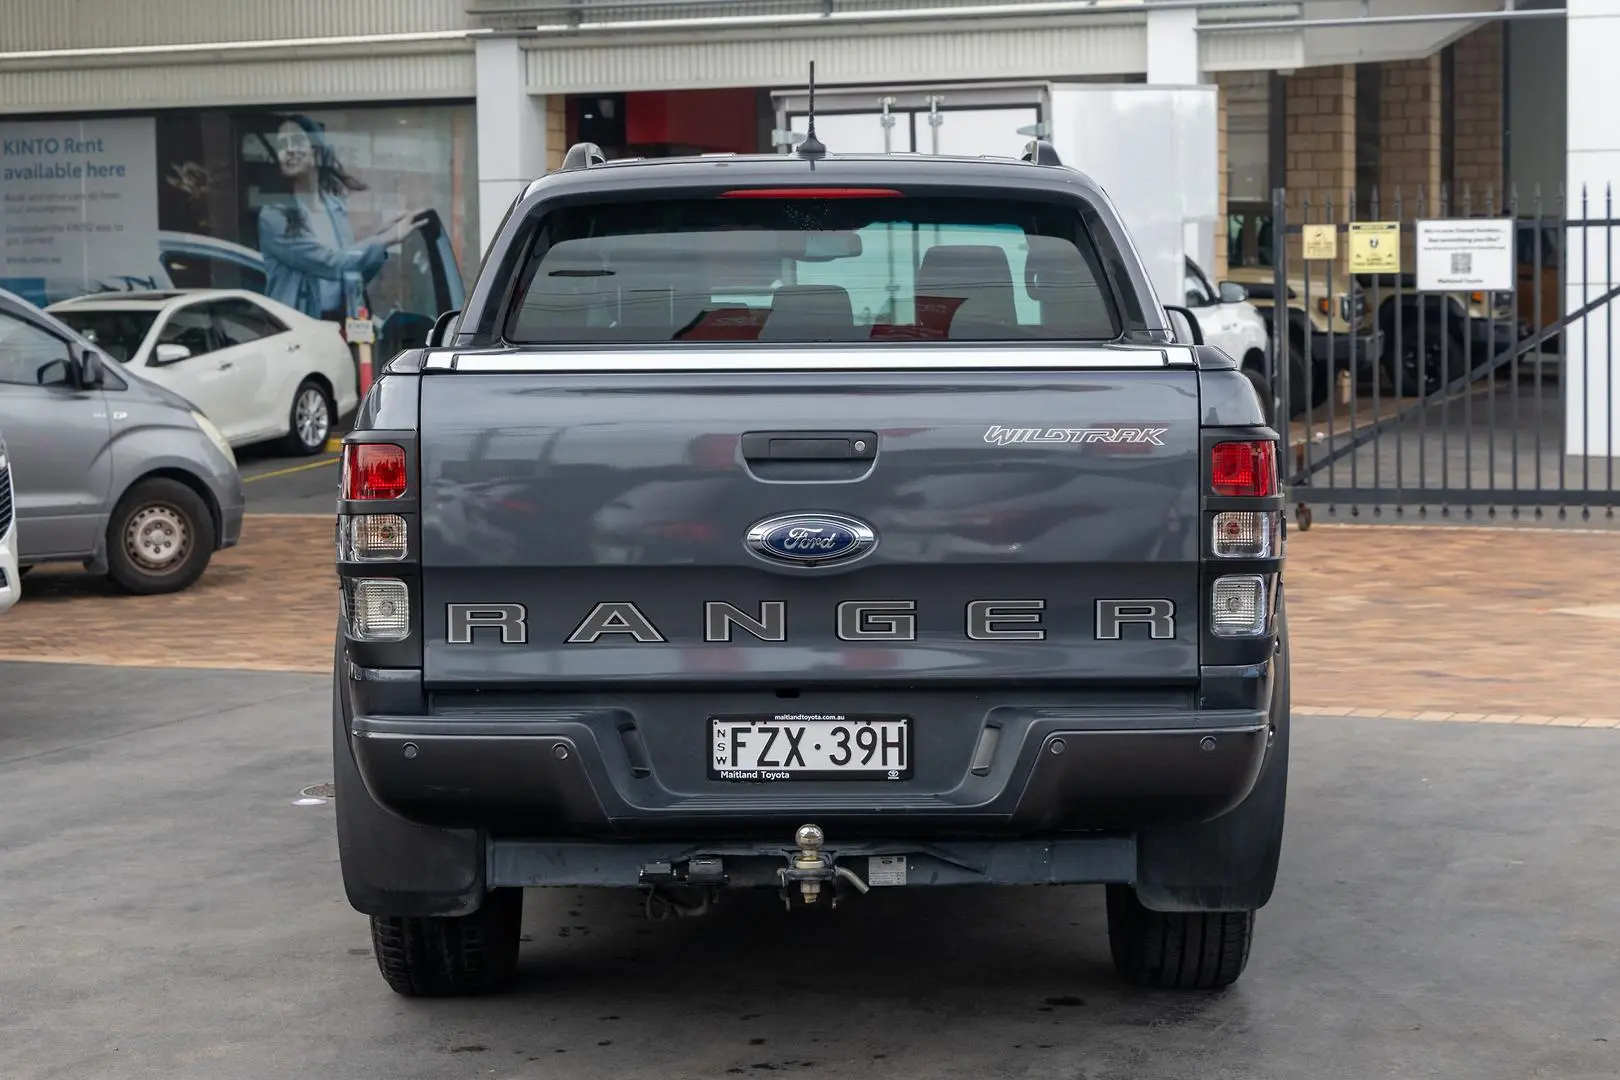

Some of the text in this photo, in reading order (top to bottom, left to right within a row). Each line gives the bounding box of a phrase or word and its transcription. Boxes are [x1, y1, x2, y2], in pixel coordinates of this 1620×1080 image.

[3, 137, 104, 156] KINTO Rent
[4, 160, 126, 181] available here
[983, 425, 1169, 446] WILDTRAK
[784, 527, 836, 551] Ford
[445, 599, 1177, 645] RANGER
[774, 714, 845, 722] maitlandtoyota.com.au
[720, 770, 790, 780] Maitland Toyota
